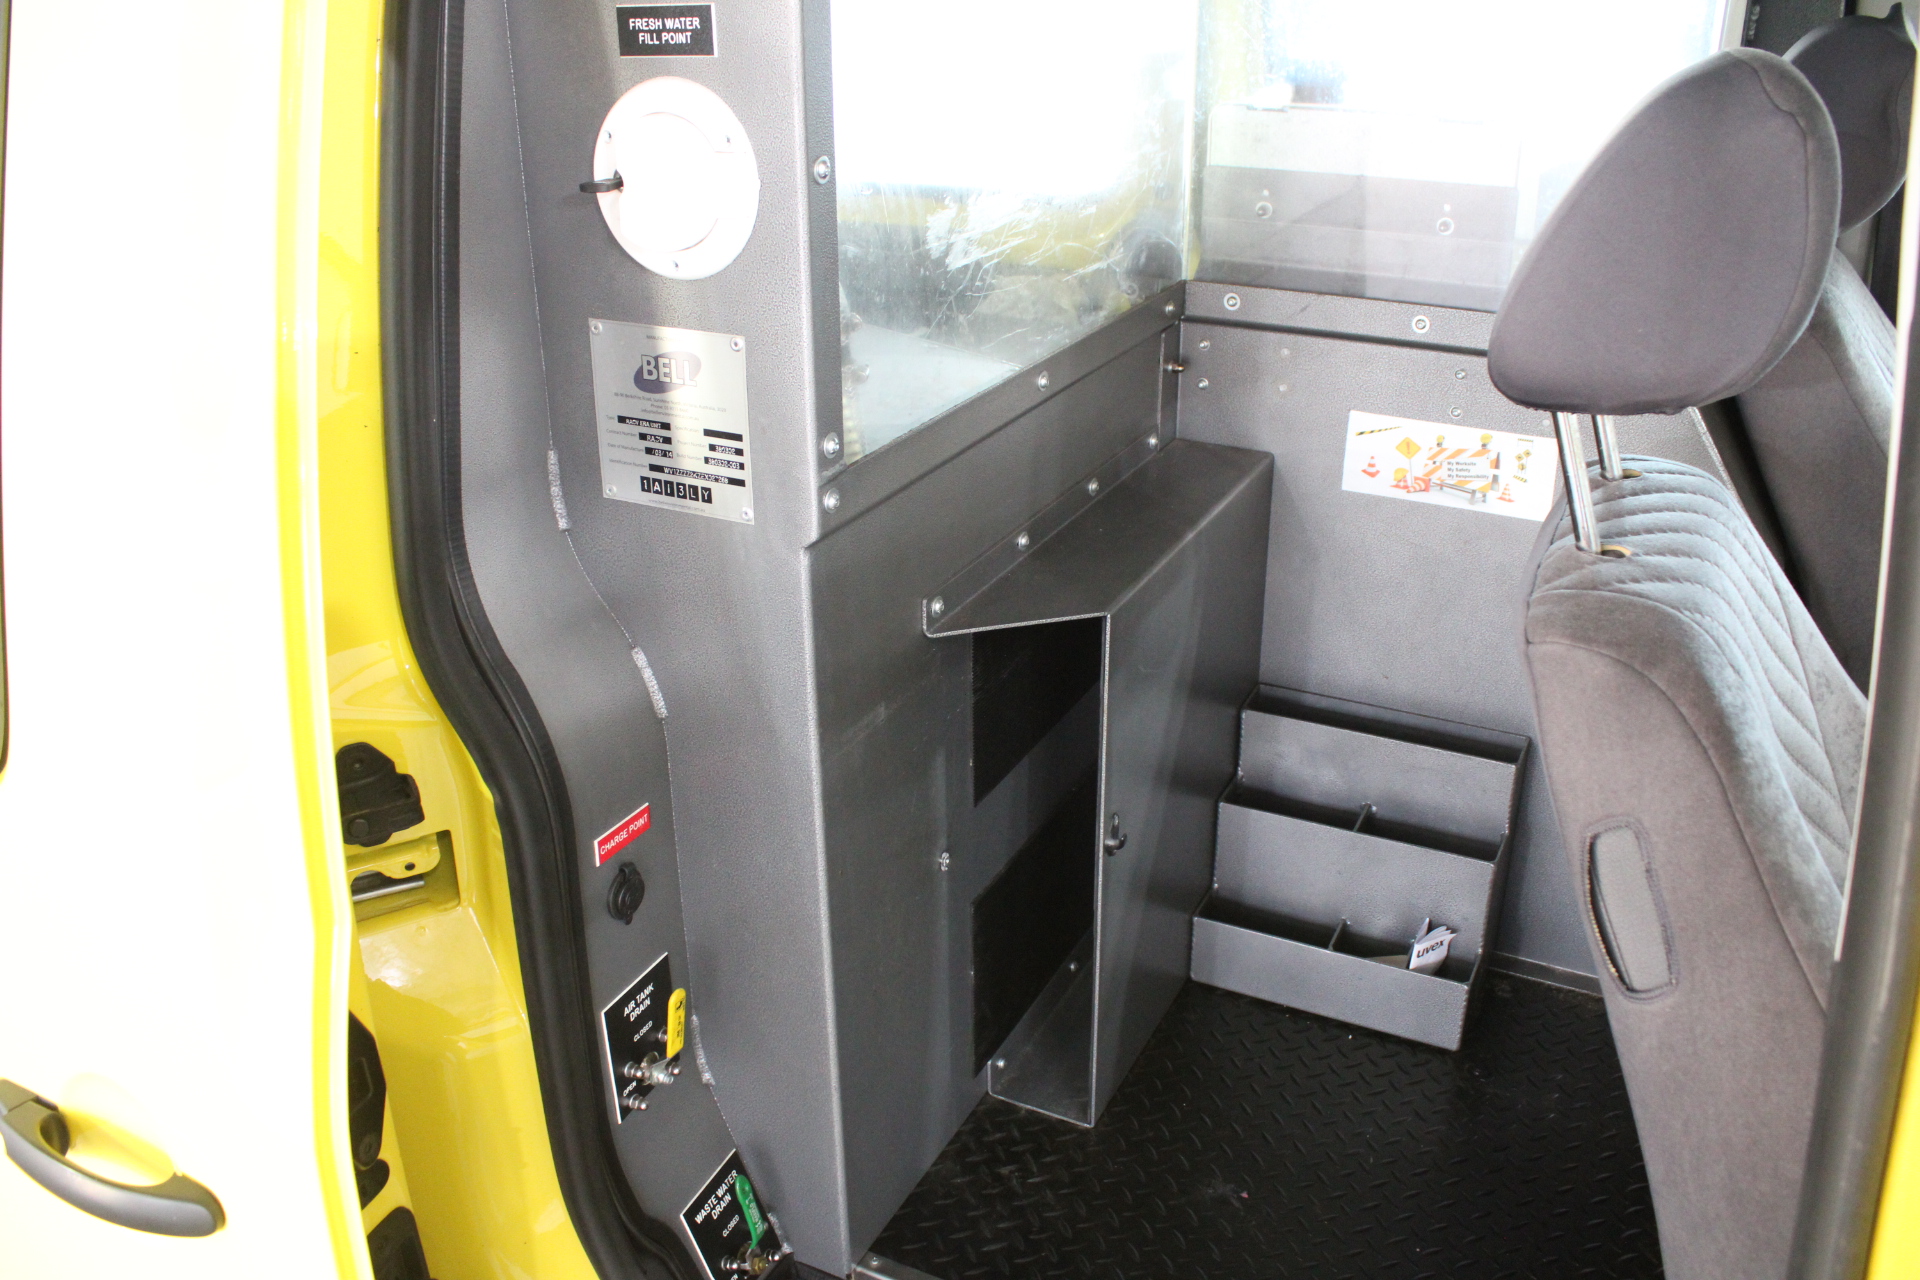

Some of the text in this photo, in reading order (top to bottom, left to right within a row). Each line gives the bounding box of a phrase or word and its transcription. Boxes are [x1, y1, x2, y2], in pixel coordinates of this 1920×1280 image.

[629, 16, 700, 31] FRESH WATER
[638, 31, 692, 45] FILL POINT
[640, 353, 698, 387] BELL
[600, 813, 649, 855] CHARGE POINT
[624, 982, 655, 1018] AIR TANK
[629, 998, 651, 1023] DRAIN
[633, 1020, 653, 1043] CLOSED
[622, 1080, 637, 1098] OPEN
[694, 1169, 739, 1224] WASTE WATER
[711, 1192, 732, 1220] DRAIN
[722, 1214, 740, 1238] CLOSED
